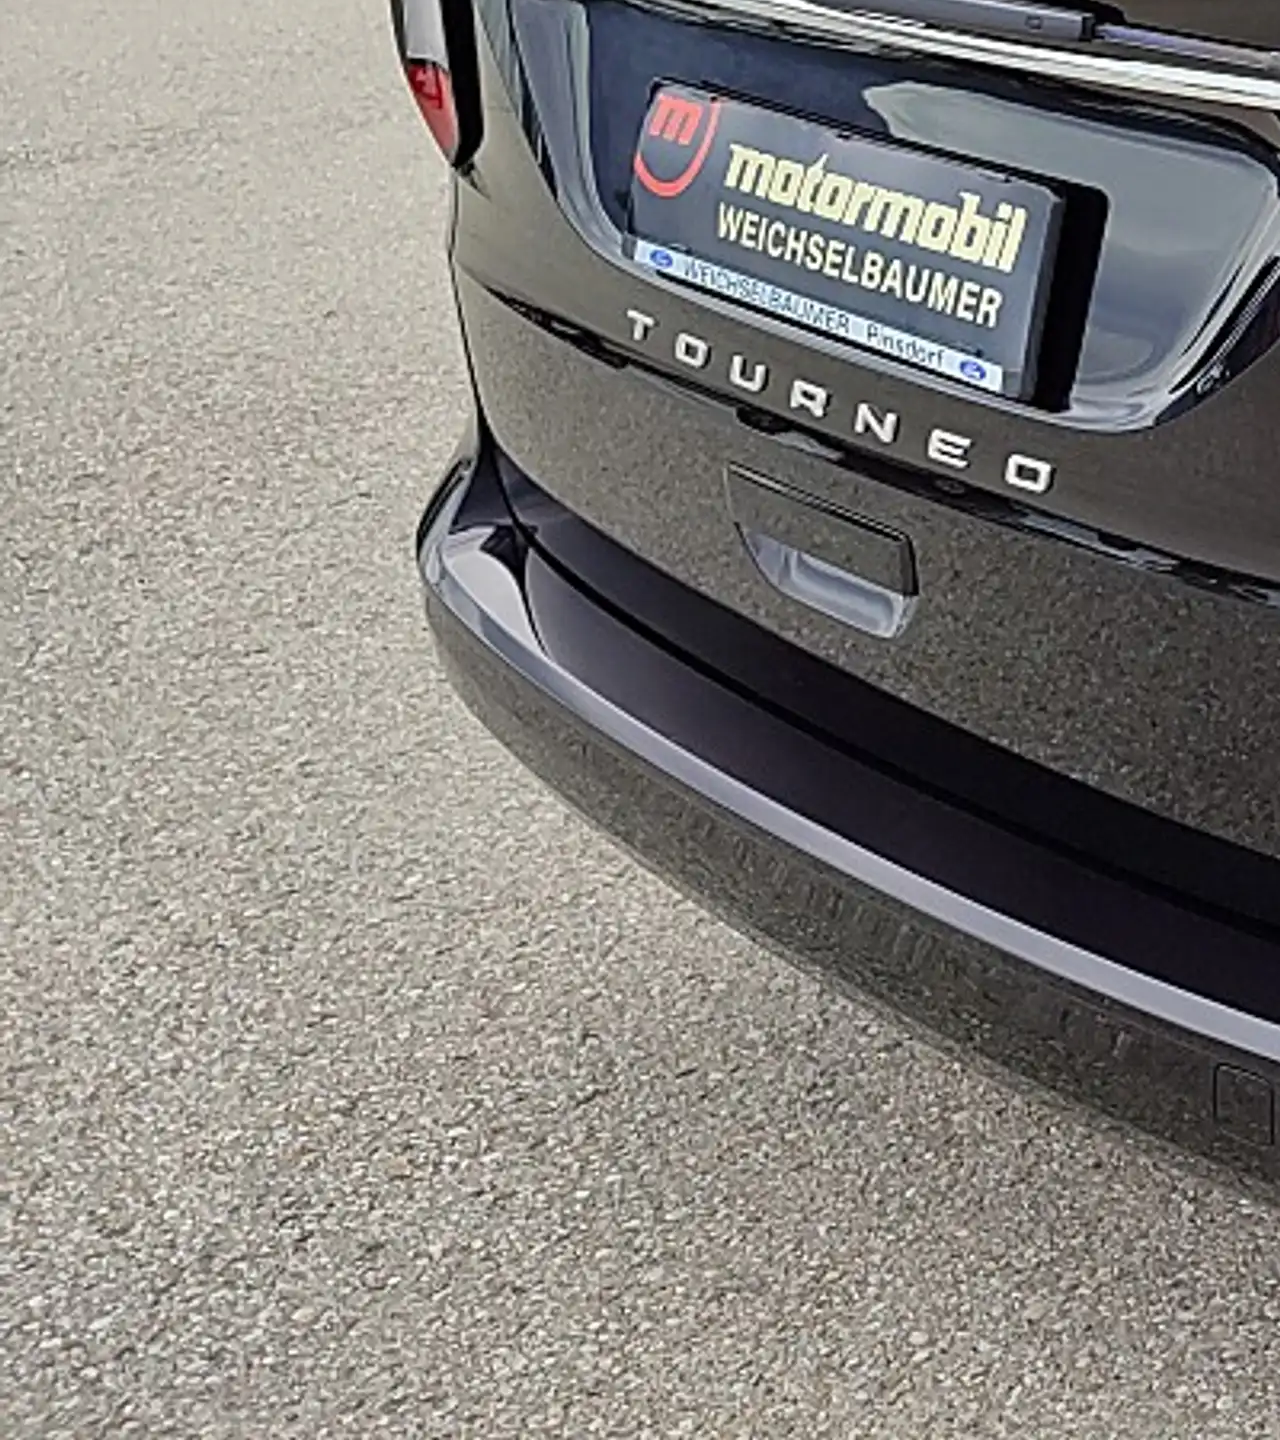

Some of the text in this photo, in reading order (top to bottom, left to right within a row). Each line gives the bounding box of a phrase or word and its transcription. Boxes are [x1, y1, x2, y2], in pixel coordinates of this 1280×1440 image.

[716, 203, 1003, 328] WEICHSELBAUMER
[723, 143, 1028, 272] motormobil
[626, 308, 1053, 494] TOURNEO
[866, 322, 945, 368] Pinsdorf
